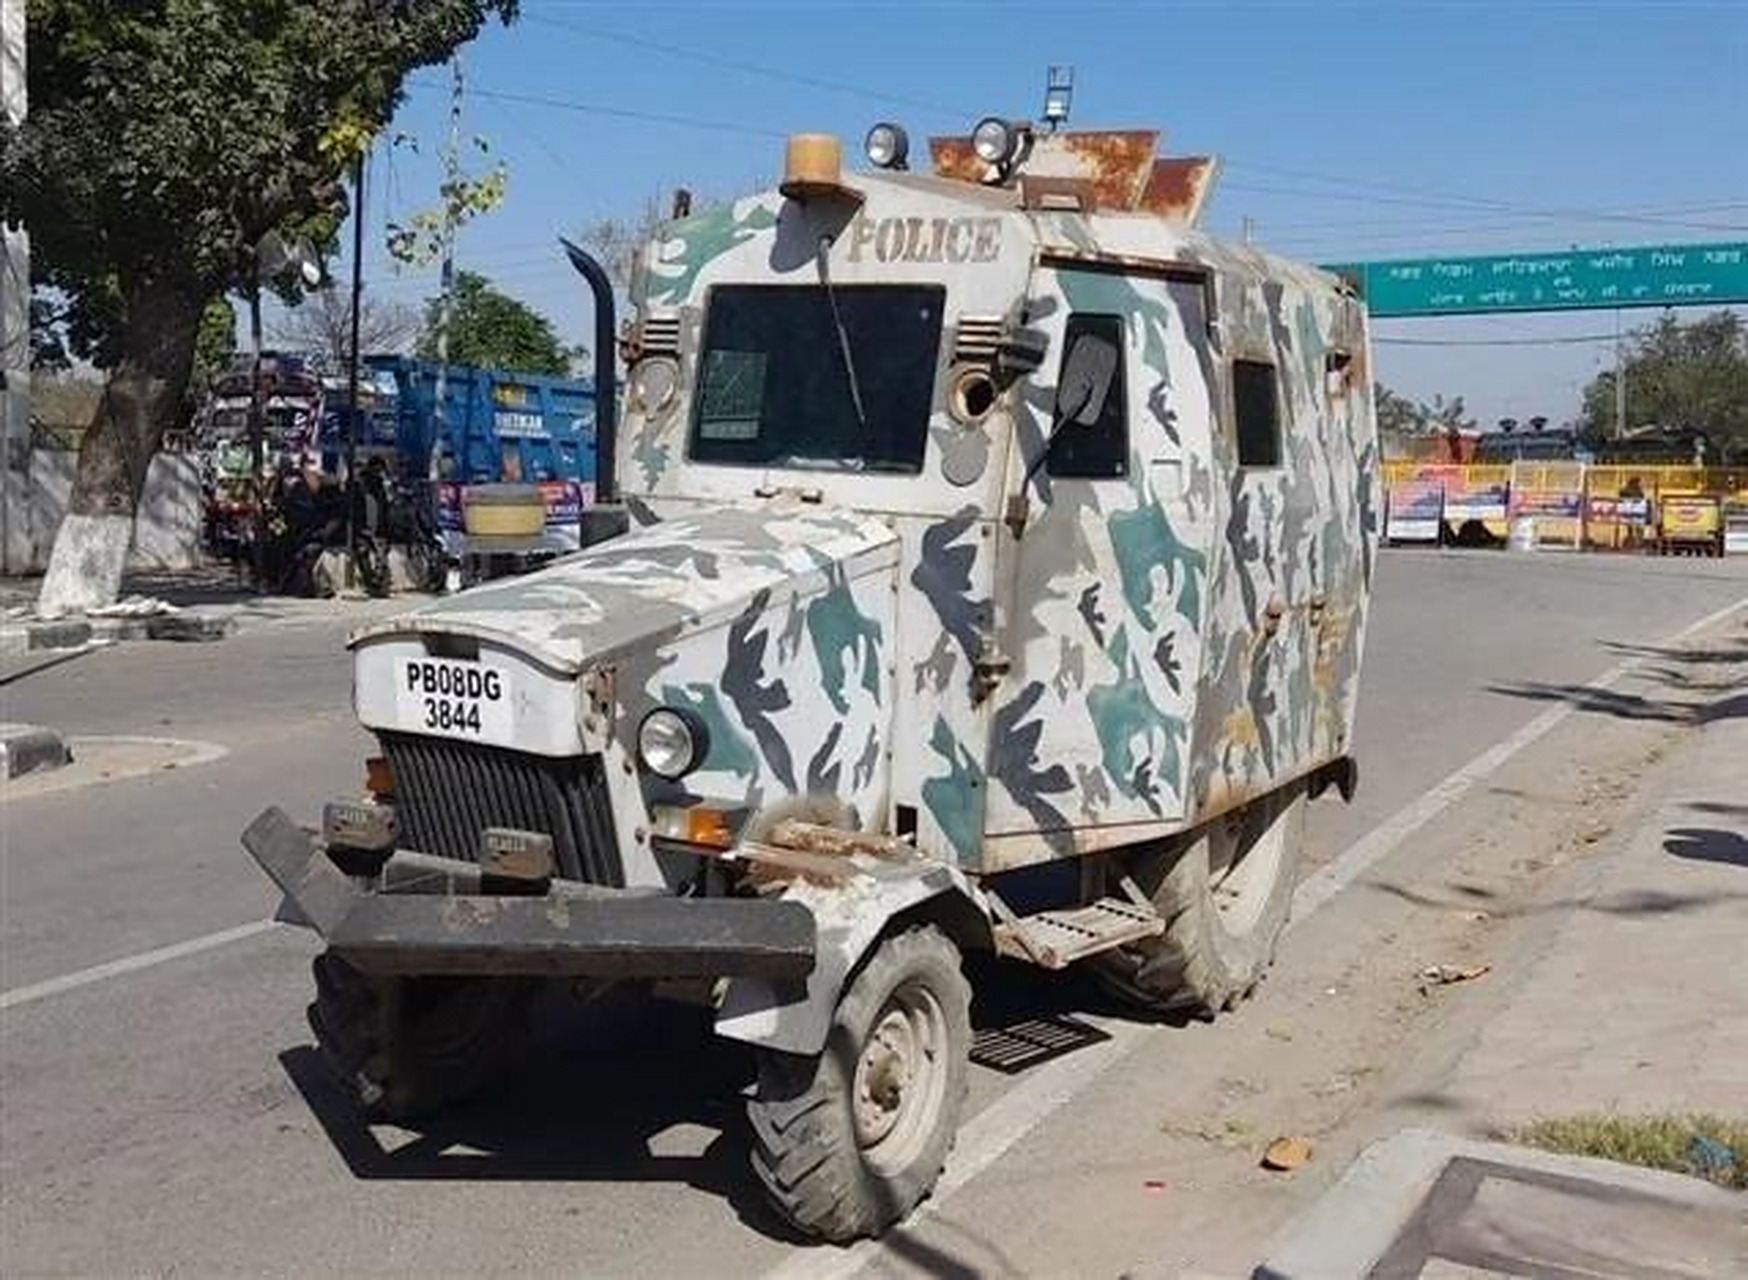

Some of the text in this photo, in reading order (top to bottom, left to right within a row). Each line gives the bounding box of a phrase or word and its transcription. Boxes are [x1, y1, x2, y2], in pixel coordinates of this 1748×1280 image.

[848, 217, 1002, 263] POLICE
[407, 662, 501, 701] PB08DG
[425, 697, 481, 734] 3844
